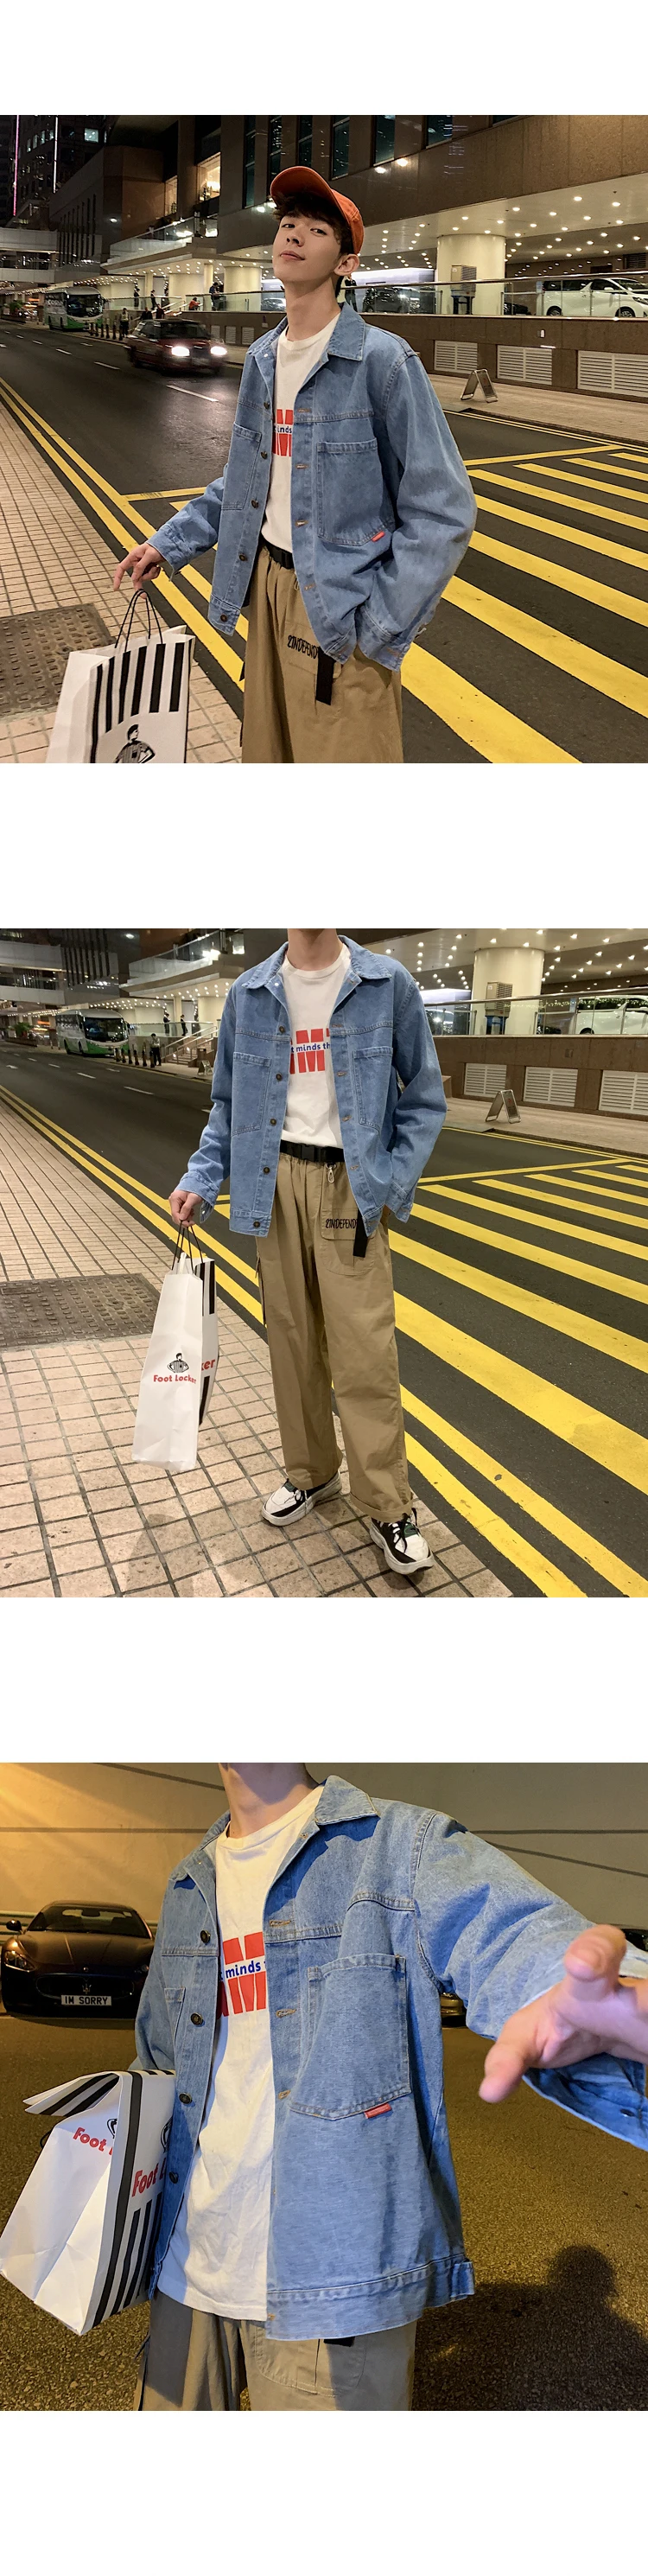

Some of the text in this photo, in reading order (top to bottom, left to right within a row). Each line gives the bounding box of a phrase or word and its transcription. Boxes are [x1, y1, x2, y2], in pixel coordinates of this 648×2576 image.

[295, 1043, 321, 1052] minds
[175, 1374, 197, 1384] Locker
[225, 1960, 261, 1979] minds
[79, 1996, 108, 2005] SORRY
[73, 2126, 106, 2152] Foot
[131, 2162, 159, 2197] Foot
